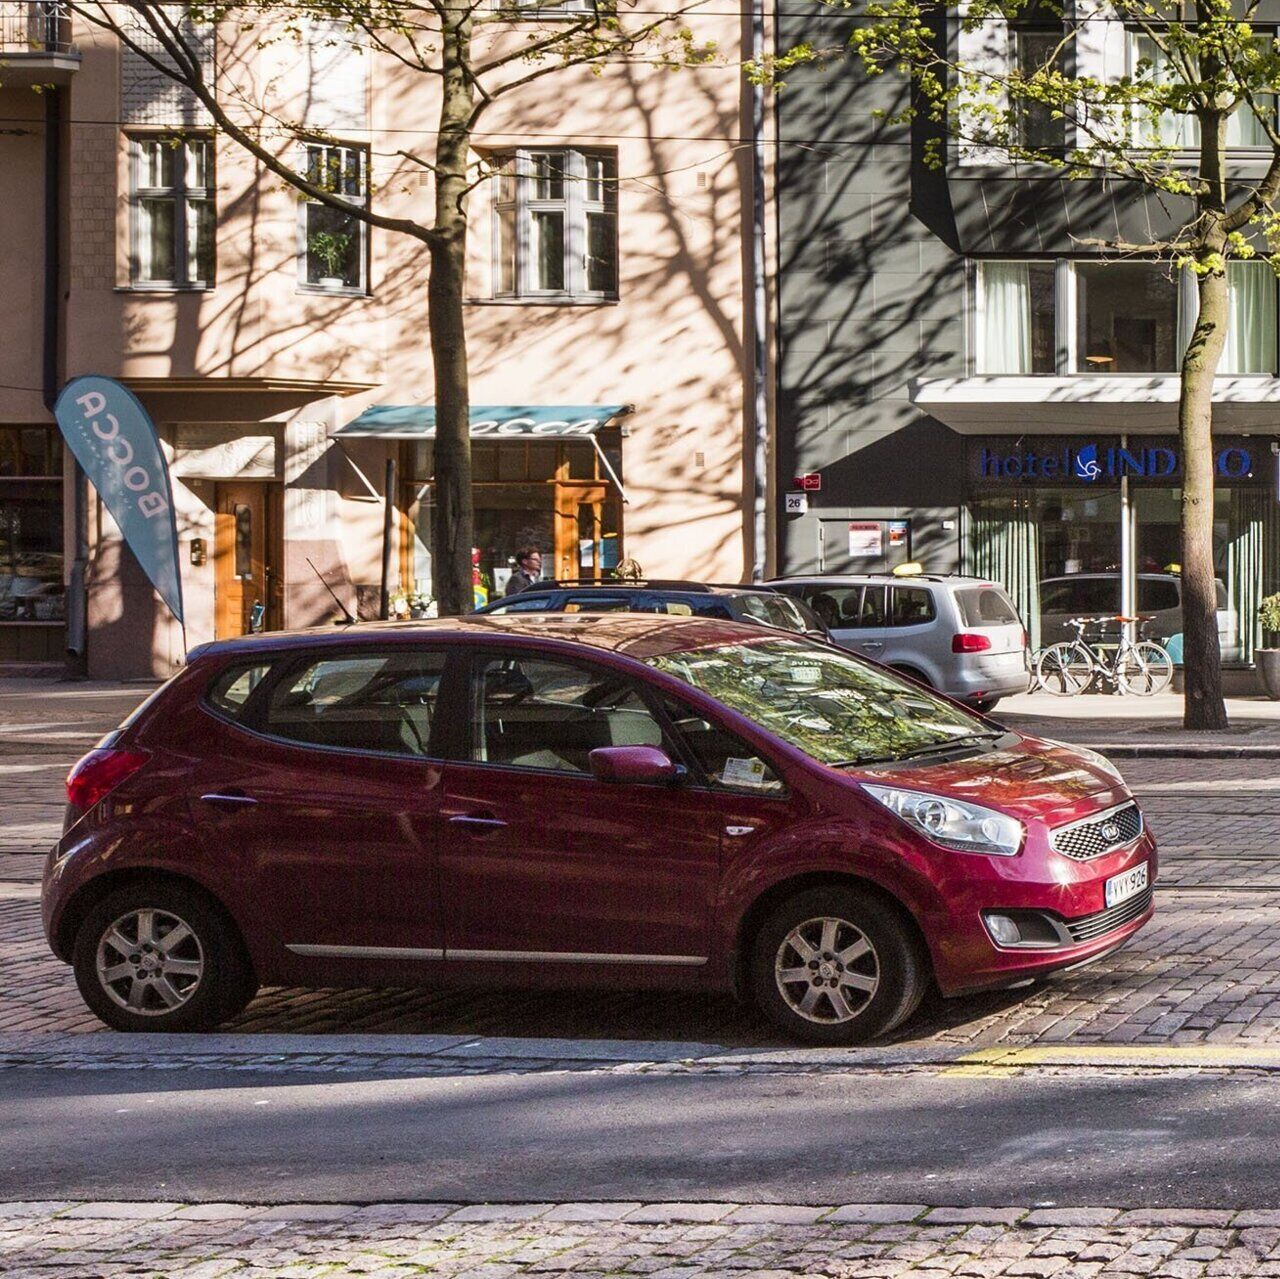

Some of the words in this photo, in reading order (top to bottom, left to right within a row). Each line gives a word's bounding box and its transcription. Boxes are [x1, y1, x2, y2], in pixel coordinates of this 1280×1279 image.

[424, 419, 600, 434] OCCA
[75, 391, 168, 518] BOCCA
[981, 447, 1069, 477] hotel
[1107, 447, 1251, 478] INDO
[788, 499, 801, 508] 26
